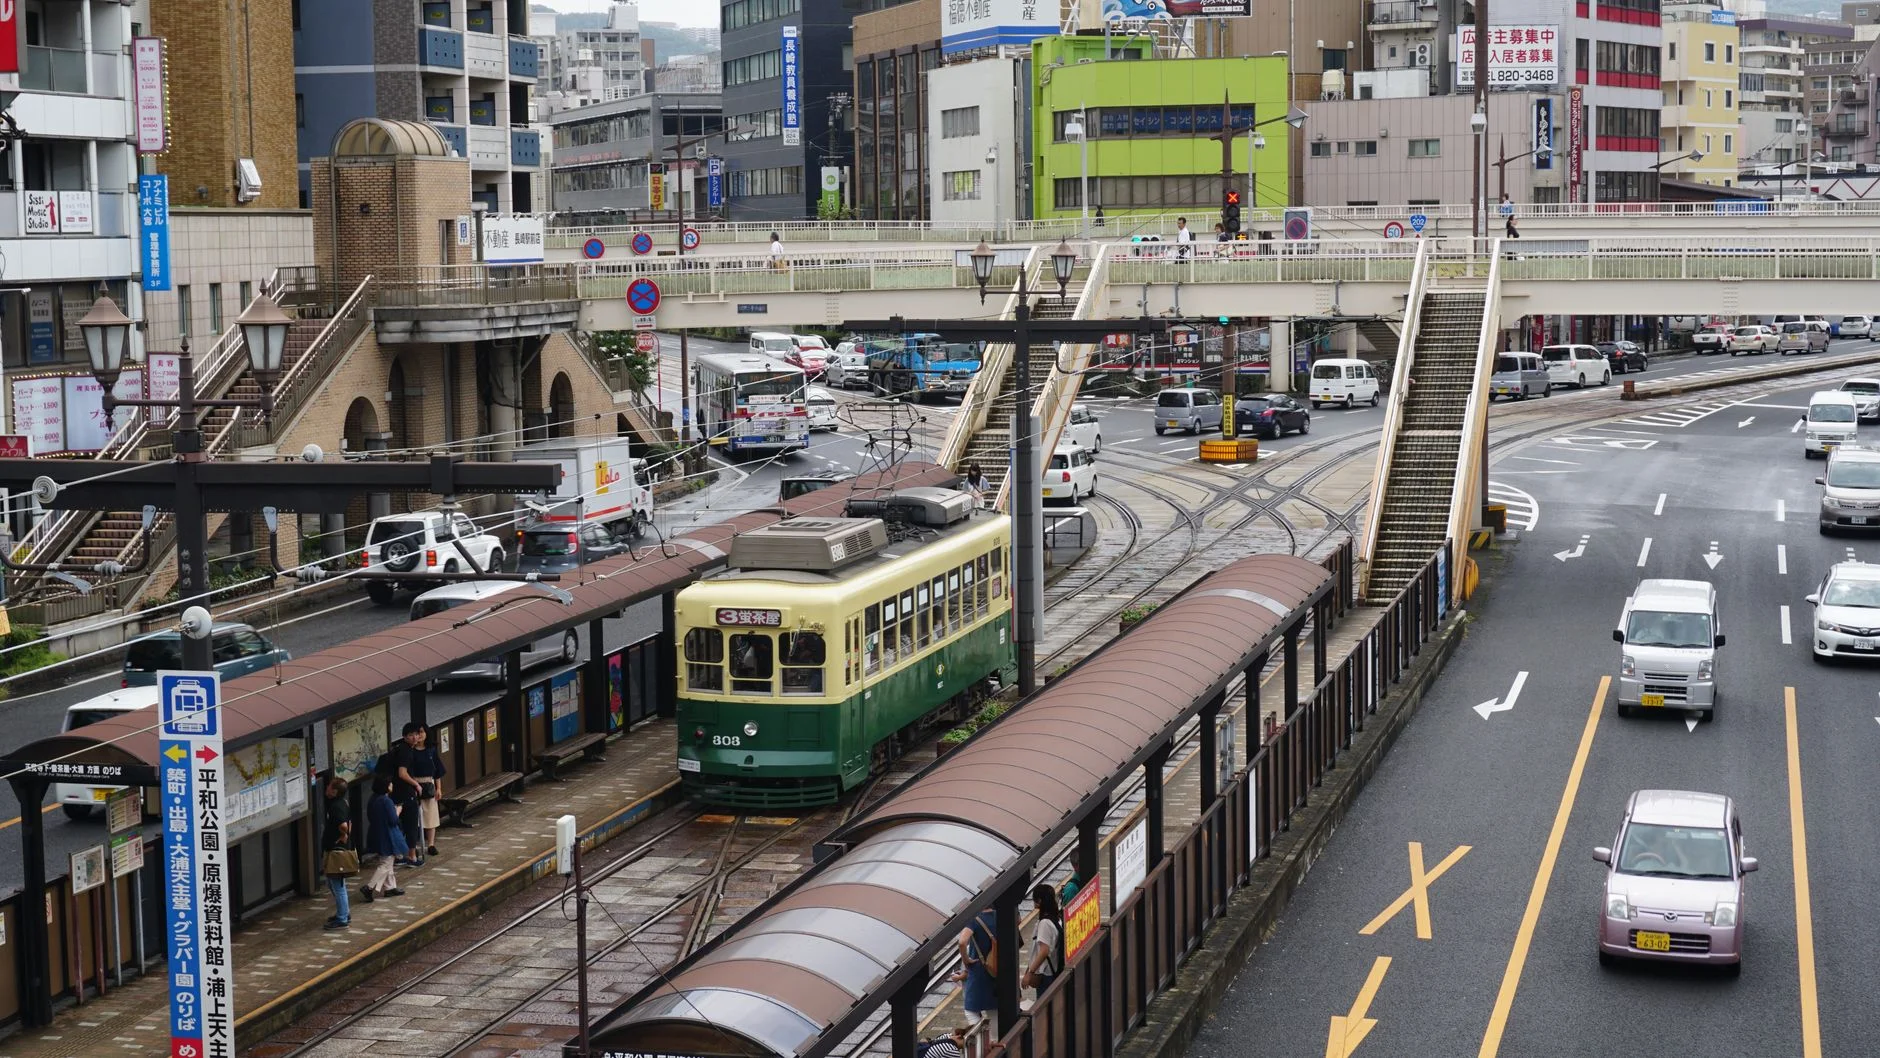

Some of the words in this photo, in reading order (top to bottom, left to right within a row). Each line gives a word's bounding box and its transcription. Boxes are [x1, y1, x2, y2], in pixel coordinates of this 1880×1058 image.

[1462, 29, 1554, 44] 広主募集中
[1462, 49, 1553, 63] 店入居者募集
[1498, 70, 1554, 81] 820-3468
[1412, 218, 1425, 226] 202
[1388, 227, 1400, 238] 50
[87, 765, 100, 775] 方面
[102, 766, 122, 775] のりば
[176, 992, 196, 1031] のりば
